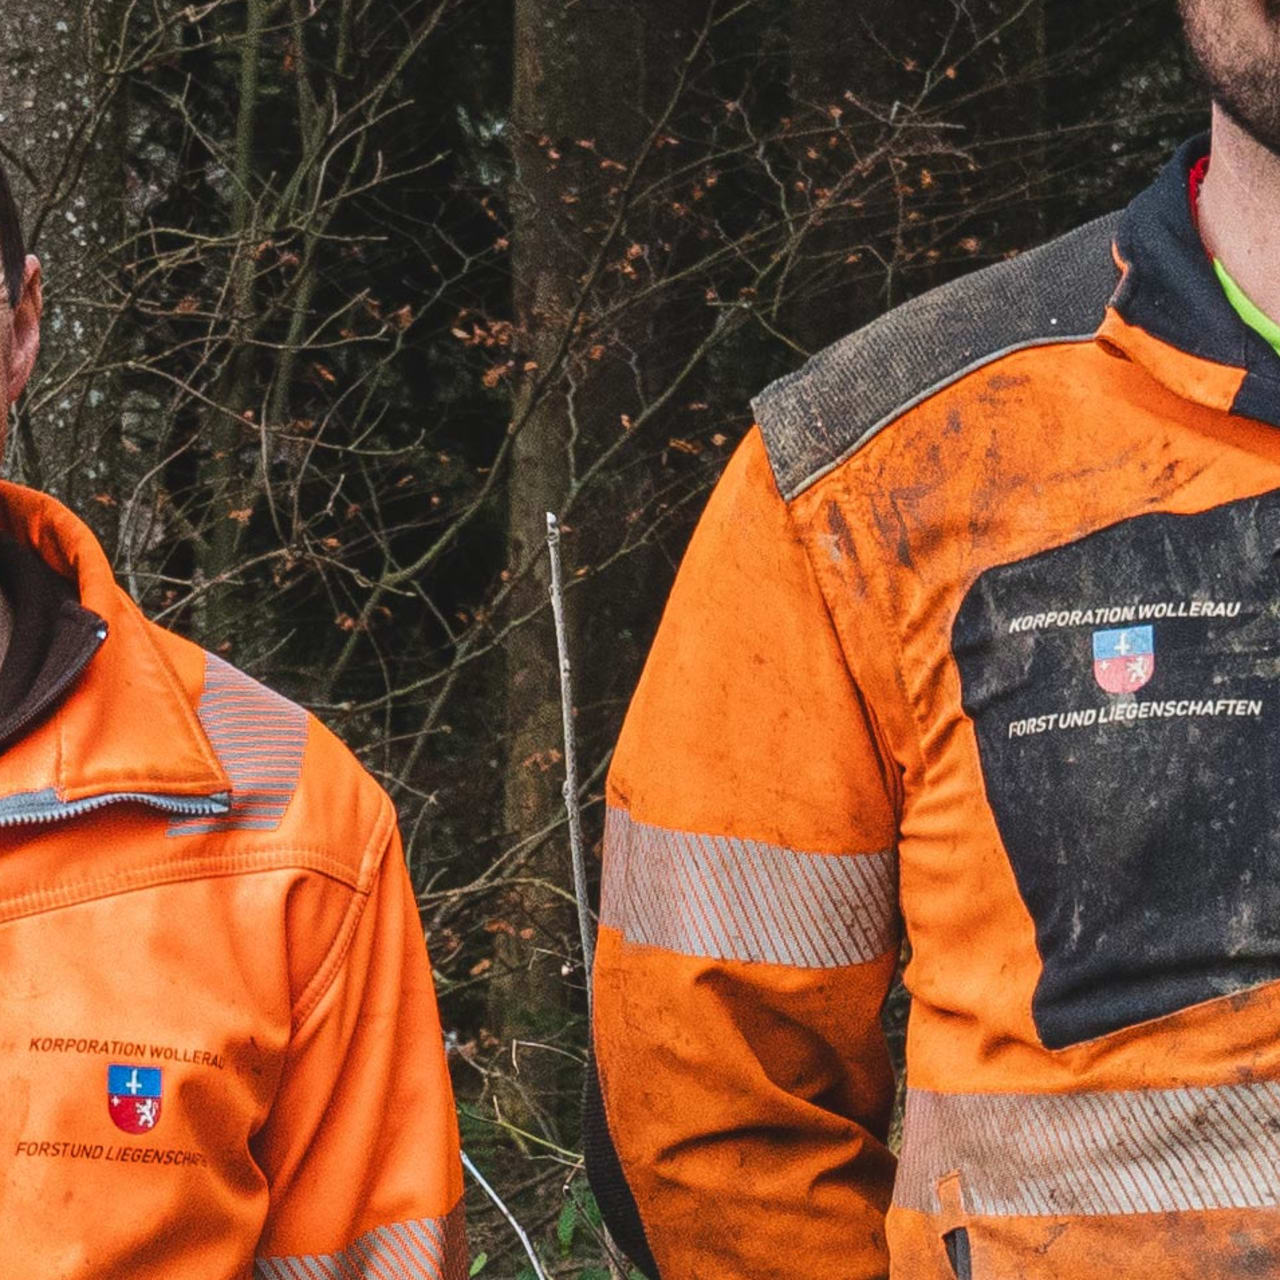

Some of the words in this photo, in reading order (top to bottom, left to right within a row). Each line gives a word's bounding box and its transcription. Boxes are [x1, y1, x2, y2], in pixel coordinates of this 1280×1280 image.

[1009, 605, 1136, 634] KORPORATION
[1138, 600, 1241, 620] WOLLERAU
[1008, 713, 1059, 739] FORST
[1058, 708, 1097, 729] UND
[1098, 700, 1263, 724] LIEGENSCHAFTEN
[28, 1038, 147, 1058] KORPORATION
[15, 1141, 71, 1158] FORST
[70, 1143, 104, 1160] UND
